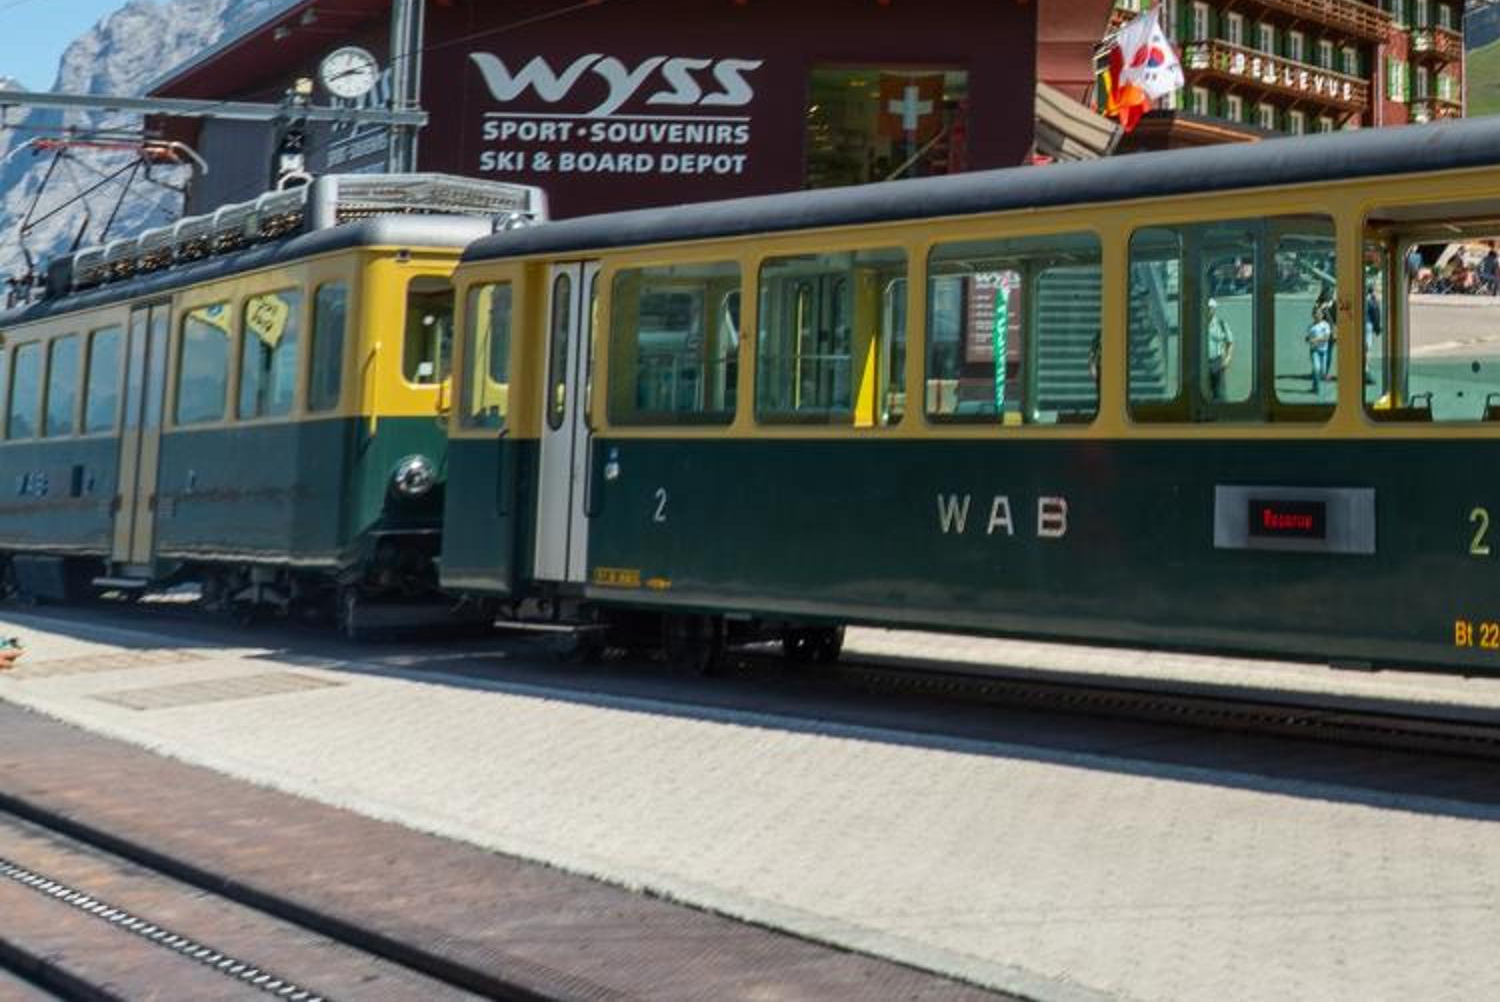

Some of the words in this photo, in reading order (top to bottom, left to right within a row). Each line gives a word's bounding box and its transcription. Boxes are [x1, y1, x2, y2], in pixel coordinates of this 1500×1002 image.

[482, 120, 573, 142] SPORT
[589, 122, 750, 145] SOUVENIRS
[479, 151, 525, 172] SKI
[531, 152, 551, 172] &
[558, 152, 654, 173] BOARD
[660, 154, 748, 174] DEPOT
[653, 487, 668, 522] 2
[1468, 507, 1490, 555] 2
